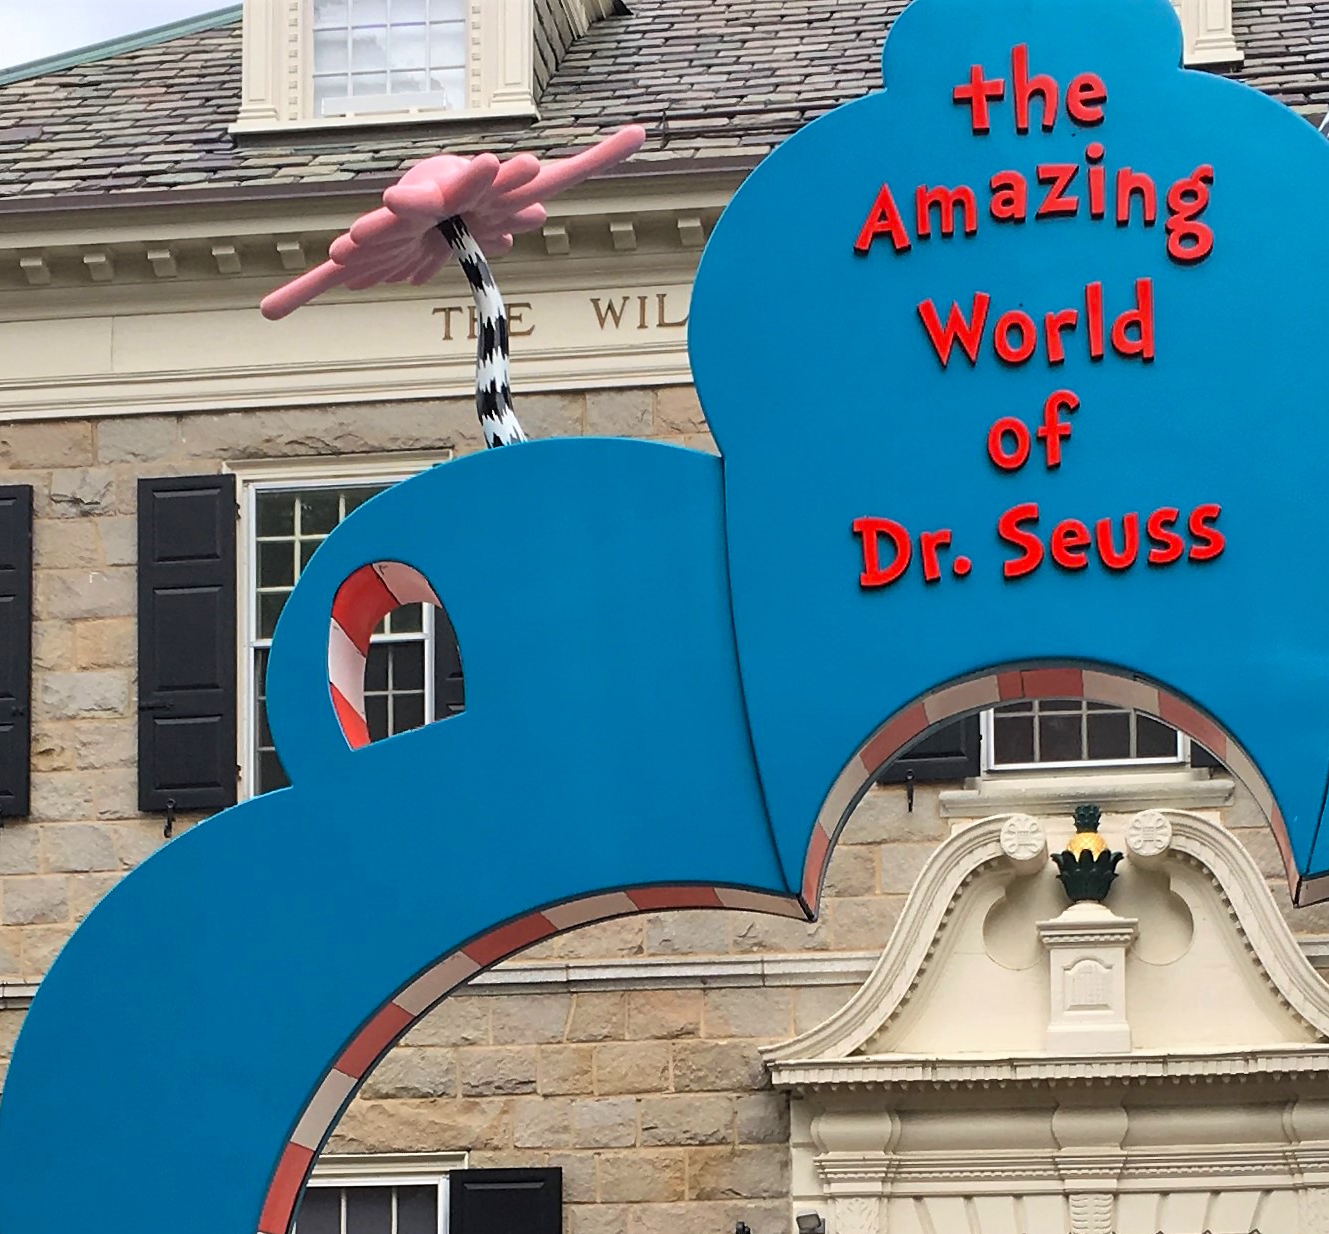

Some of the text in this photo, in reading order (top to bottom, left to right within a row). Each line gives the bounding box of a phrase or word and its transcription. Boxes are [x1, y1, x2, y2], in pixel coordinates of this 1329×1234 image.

[953, 43, 1107, 133] the
[853, 142, 1214, 263] Amazing
[917, 277, 1155, 367] World
[987, 389, 1080, 470] of
[851, 502, 1226, 588] Dr. Seuss
